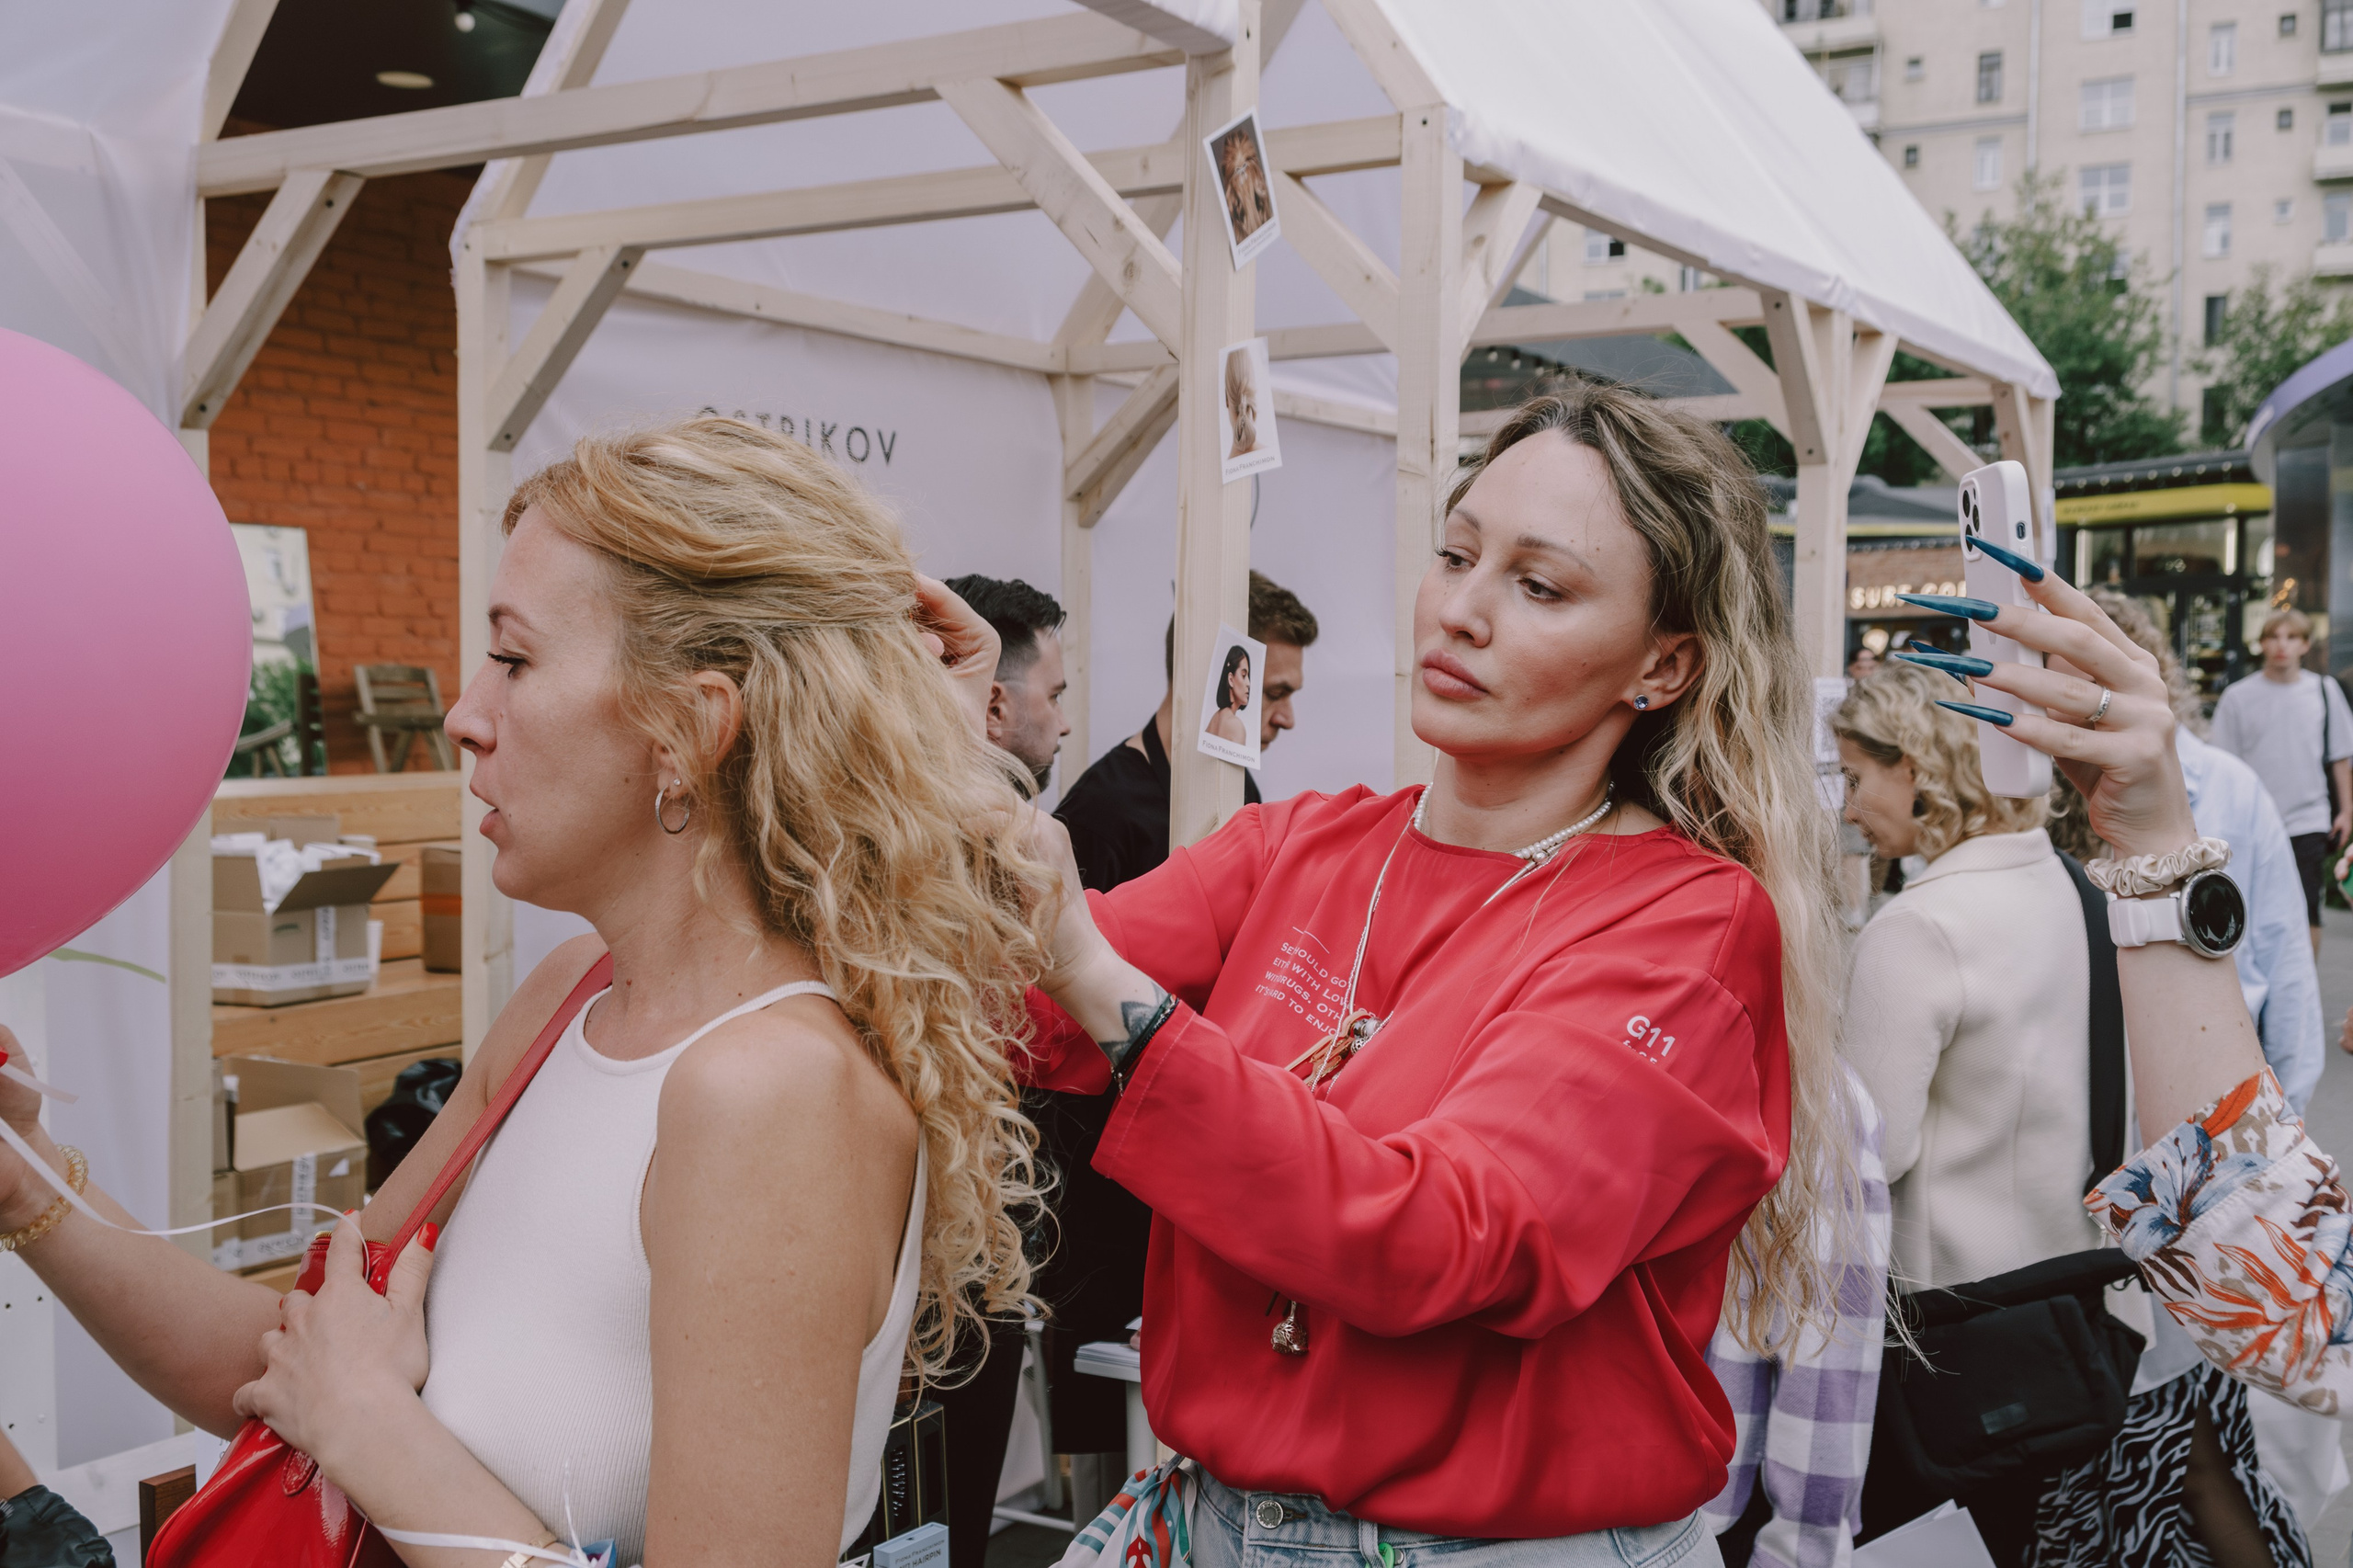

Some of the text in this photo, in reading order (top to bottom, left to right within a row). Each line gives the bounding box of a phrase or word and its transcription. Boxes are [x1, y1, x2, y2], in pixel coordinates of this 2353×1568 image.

[694, 406, 896, 466] TRIKOV
[1849, 584, 1913, 610] SURF
[1202, 740, 1256, 763] FIONA FRANCHIMON
[1291, 962, 1321, 991] WITH
[1330, 976, 1347, 988] GO
[1288, 998, 1304, 1014] TO
[1305, 1014, 1338, 1037] ENJO
[1626, 1015, 1676, 1057] G11
[912, 1549, 942, 1568] HAIRPIN
